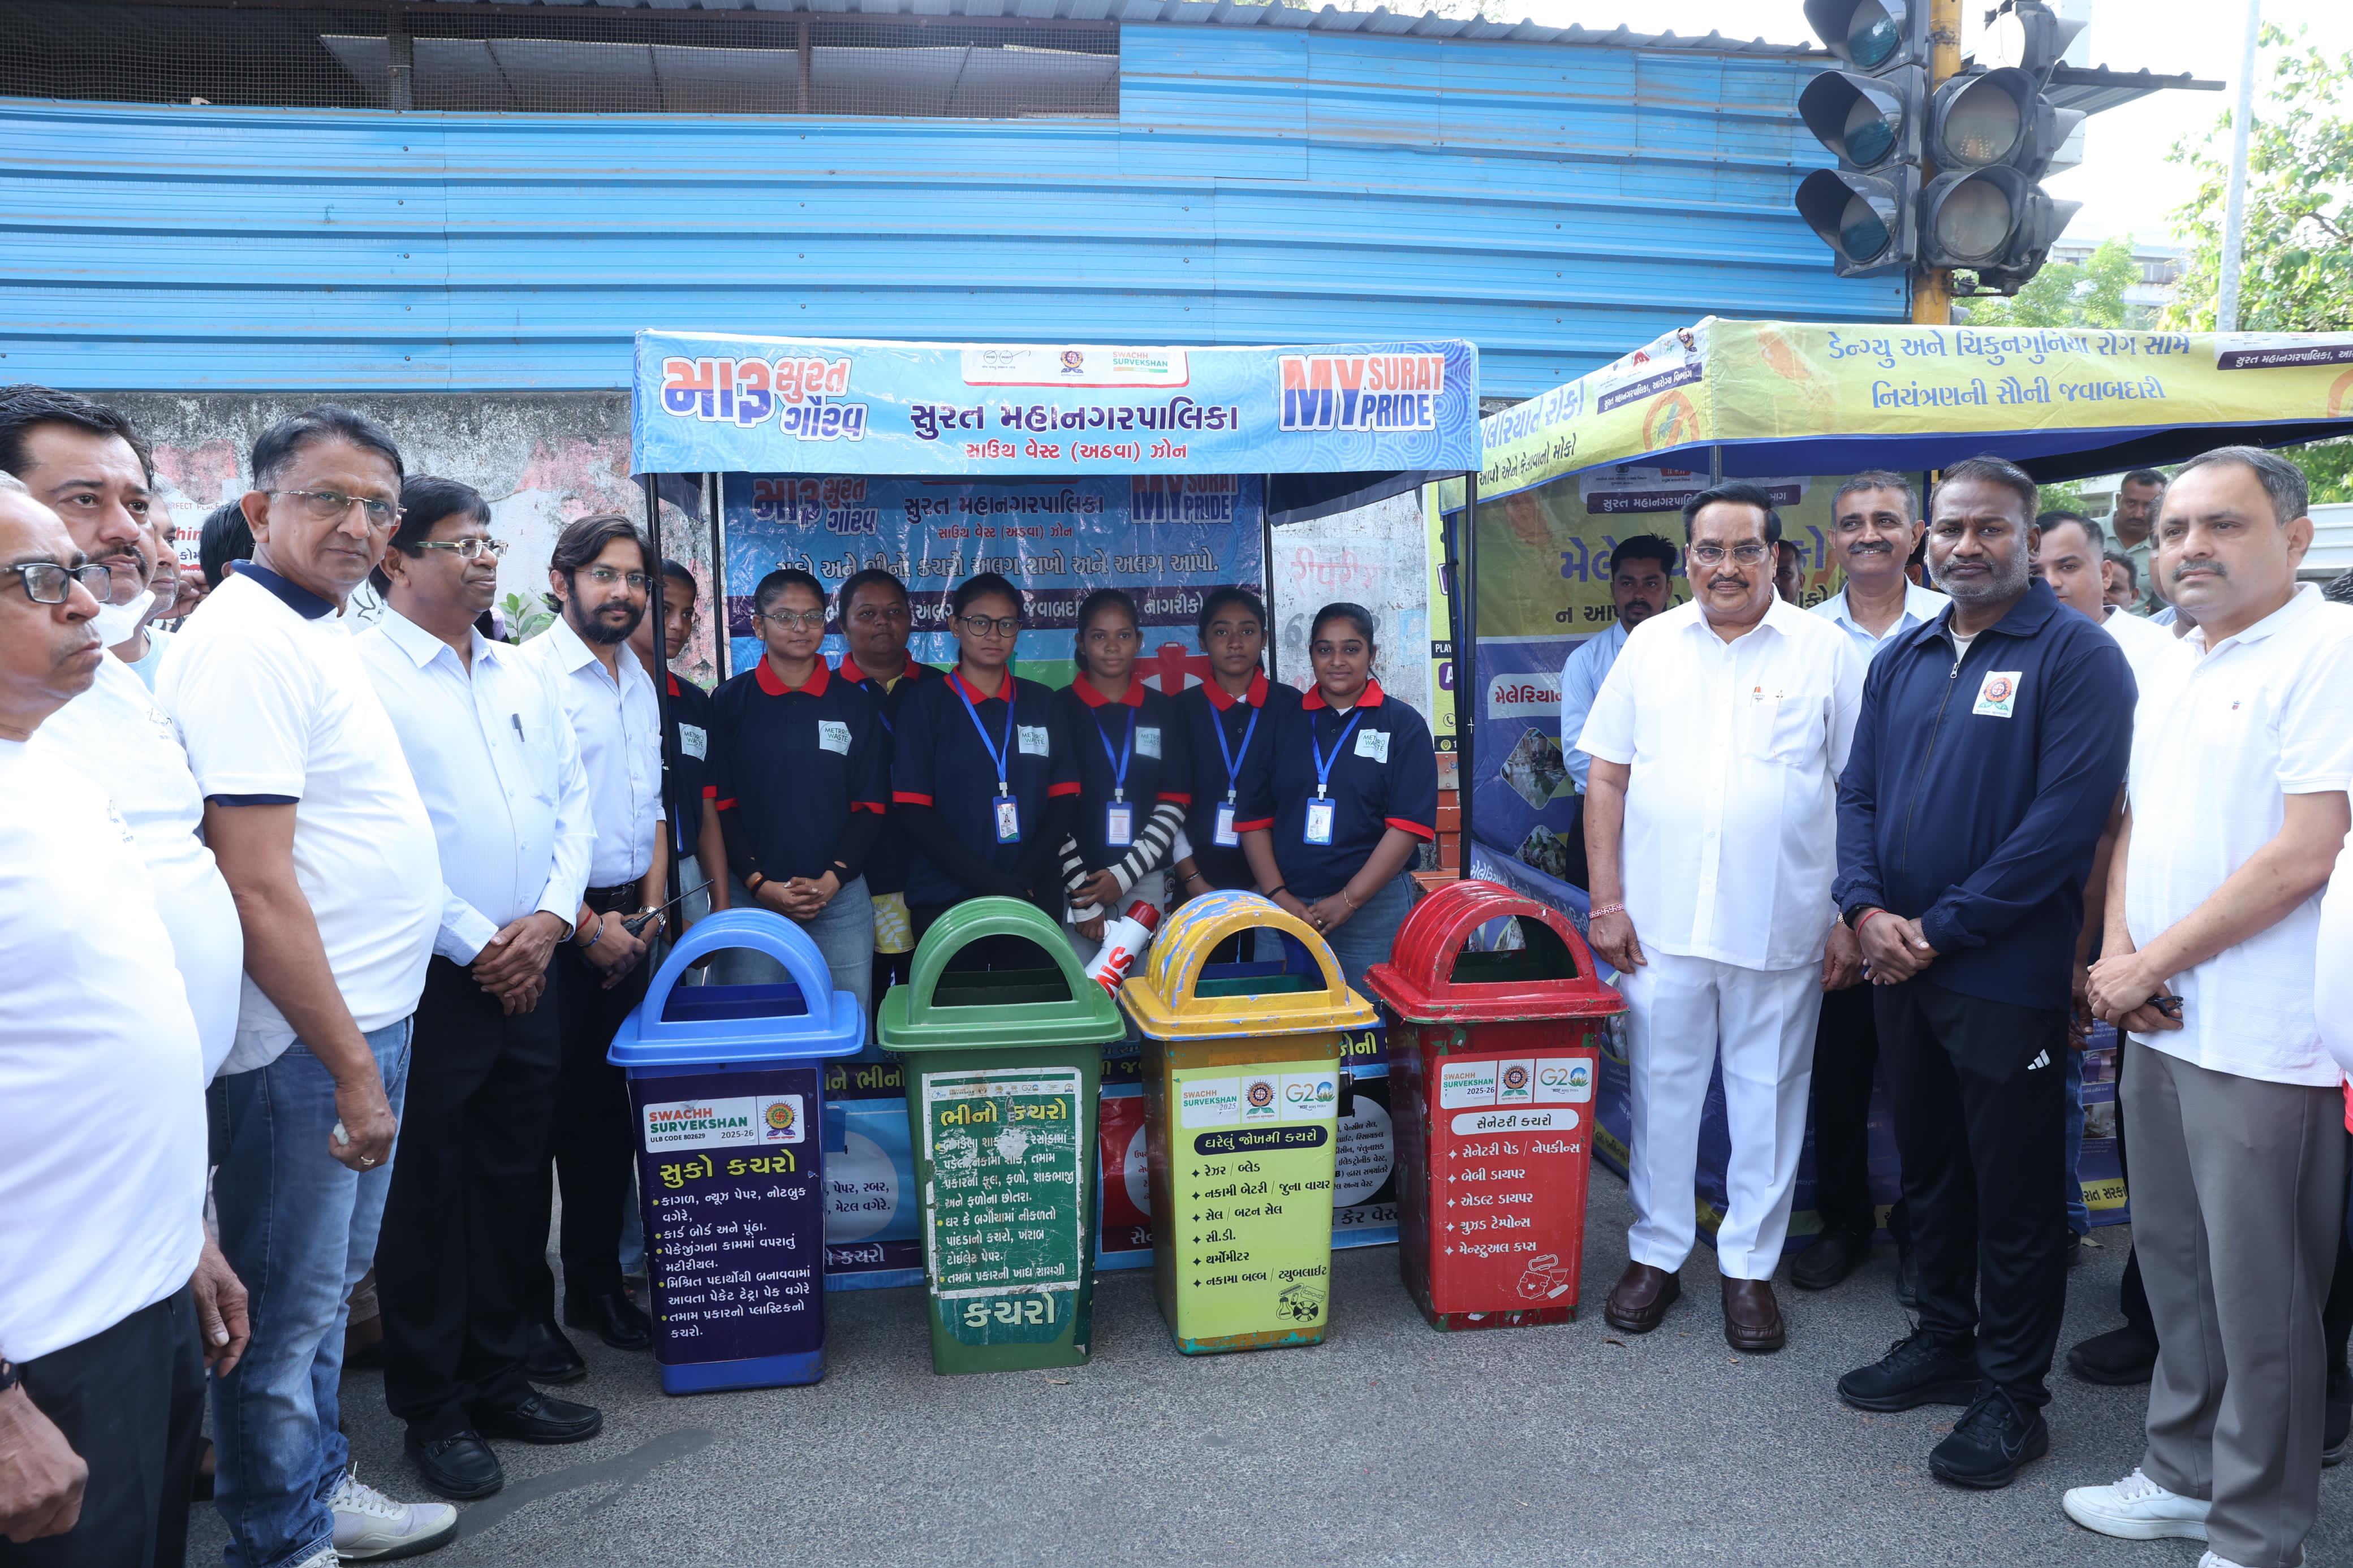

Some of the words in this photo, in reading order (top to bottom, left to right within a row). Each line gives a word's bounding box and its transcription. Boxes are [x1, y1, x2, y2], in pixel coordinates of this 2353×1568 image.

[1901, 330, 1947, 356] અને
[1955, 330, 2091, 366] ચિકુનગુનિયા
[2097, 331, 2136, 356] રોગ
[1113, 358, 1167, 367] SURVEKSHAN
[2235, 356, 2259, 368] સુરત
[1369, 357, 1445, 391] SURAT
[775, 361, 847, 404] સુરત
[1283, 357, 1367, 427] MY
[1871, 378, 1988, 409] નિયંત્રણની
[2058, 375, 2166, 401] જવાબદારી
[911, 404, 984, 440] સુરત
[1000, 397, 1238, 432] મહાનગરપાલિકા
[1360, 395, 1432, 427] PRIDE
[966, 439, 1016, 460] સાઉથ
[1025, 439, 1061, 459] વેસ્ટ
[1150, 438, 1187, 459] ઝોન
[1186, 495, 1230, 520] PRIDE
[1603, 498, 1628, 512] સુરત
[1114, 554, 1164, 573] અલગ
[1555, 607, 1573, 623] ન
[828, 733, 848, 742] WASTE
[1443, 1072, 1476, 1081] SWACHH
[1443, 1078, 1494, 1088] SURVEKSHAN
[1183, 1090, 1217, 1099] SWACHH
[1467, 1086, 1495, 1095] 2025-26
[1183, 1095, 1237, 1107] SURVEKSHAN
[1218, 1103, 1237, 1111] 2025
[649, 1108, 713, 1122] SWACHH
[940, 1100, 998, 1126] ભીનો
[1014, 1098, 1068, 1121] કચરો
[650, 1116, 748, 1134] SURVEKSHAN
[1477, 1116, 1516, 1129] સેનેટરી
[1521, 1113, 1552, 1127] કચરો
[721, 1130, 754, 1139] 2025-26
[1205, 1134, 1235, 1150] ઘરેલું
[1238, 1131, 1280, 1146] જોખમી
[1285, 1128, 1317, 1142] કચરો
[1462, 1140, 1499, 1158] સેનેટરી
[1503, 1141, 1519, 1155] પેડ
[1532, 1139, 1580, 1154] નેપકીન્સ
[1031, 1152, 1055, 1163] તમામ
[660, 1154, 713, 1189] સુકો
[727, 1148, 795, 1176] કચરો
[1204, 1164, 1227, 1177] રેઝર
[1238, 1161, 1261, 1173] બ્લેડ
[1461, 1167, 1486, 1182] બેબી
[1490, 1169, 1526, 1180] ડાયપર
[1033, 1171, 1074, 1185] શાકભાજી
[661, 1195, 699, 1206] કાગળ,
[734, 1188, 761, 1201] પેપર,
[767, 1186, 806, 1200] નોટબુક
[833, 1181, 859, 1195] પેપર,
[863, 1181, 889, 1194] રબર,
[1205, 1184, 1237, 1199] નકામી
[1240, 1181, 1268, 1195] બેટરી
[1279, 1182, 1302, 1196] જુના
[1305, 1180, 1330, 1191] વાયર
[835, 1199, 859, 1213] મેટલ
[863, 1198, 891, 1211] વગેરે.
[945, 1193, 963, 1207] અને
[967, 1190, 998, 1206] ફળોના
[1001, 1189, 1032, 1204] છોતરા.
[1460, 1193, 1494, 1206] એડલ્ટ
[1498, 1193, 1534, 1204] ડાયપર
[662, 1209, 693, 1223] વગેરે,
[946, 1217, 958, 1227] ઘર
[963, 1212, 970, 1226] કે
[1018, 1206, 1056, 1221] નીકળતો
[1205, 1208, 1223, 1221] સેલ
[1235, 1207, 1261, 1217] બટન
[1265, 1203, 1283, 1215] સેલ
[663, 1226, 685, 1239] કાર્ડ
[689, 1223, 712, 1238] બોર્ડ
[717, 1221, 738, 1234] અને
[986, 1228, 1014, 1243] કચરો,
[1018, 1229, 1045, 1240] ખરાબ
[722, 1236, 755, 1251] કામમાં
[760, 1233, 796, 1250] વપરાતું
[1514, 1241, 1537, 1252] કપ્સ
[756, 1265, 811, 1281] બનાવવામાં
[947, 1272, 972, 1284] તમામ
[976, 1266, 1009, 1282] પ્રકારની
[1206, 1273, 1238, 1286] નકામા
[1242, 1271, 1267, 1282] બલ્બ
[669, 1294, 705, 1305] આવતા
[710, 1289, 734, 1302] પેકેટ
[764, 1285, 781, 1299] પેક
[785, 1282, 810, 1295] વગેરે
[669, 1311, 699, 1322] તમામ
[704, 1304, 744, 1320] પ્રકારનો
[963, 1292, 1055, 1328] કચરો
[670, 1325, 703, 1338] કચરો.
